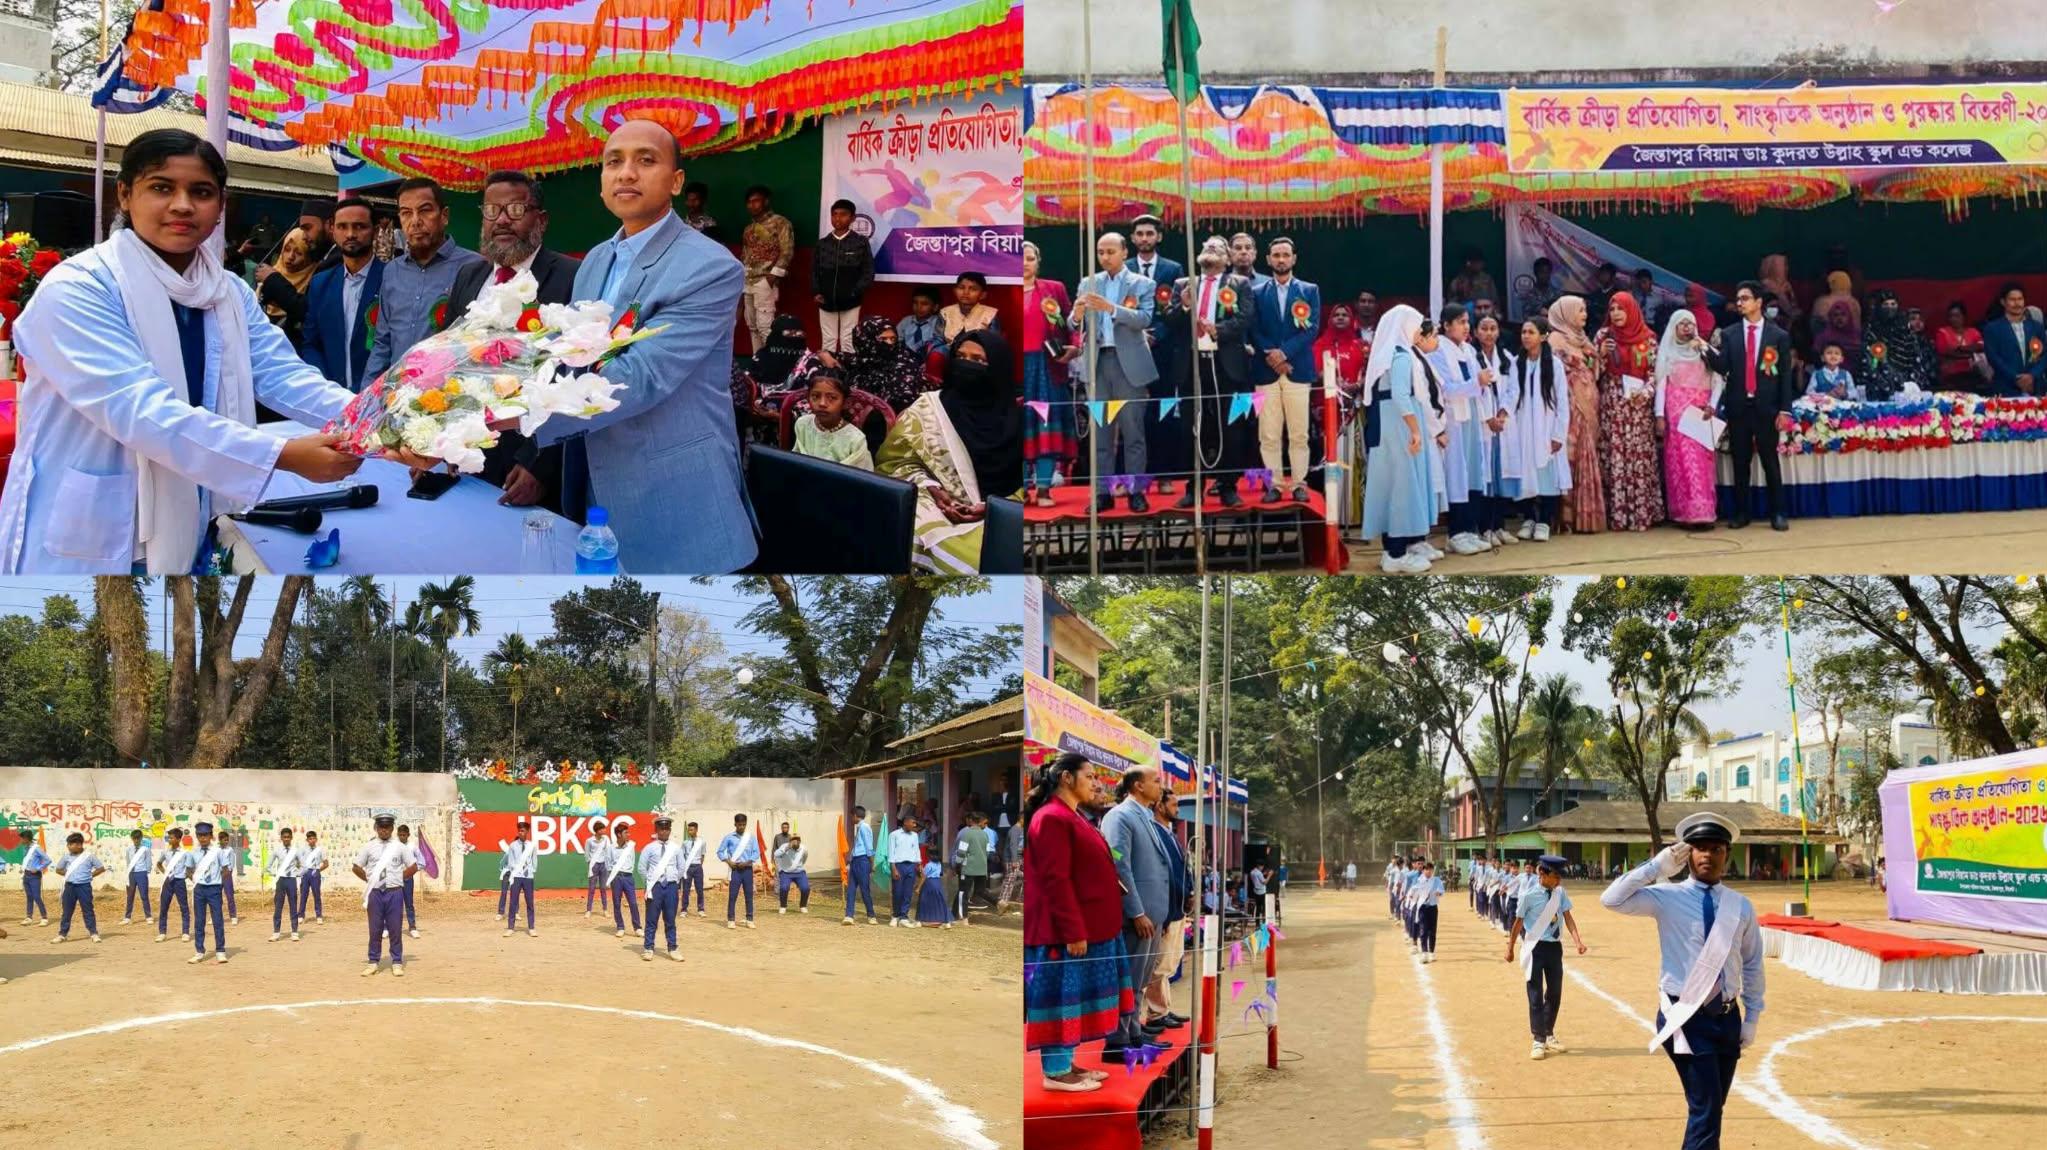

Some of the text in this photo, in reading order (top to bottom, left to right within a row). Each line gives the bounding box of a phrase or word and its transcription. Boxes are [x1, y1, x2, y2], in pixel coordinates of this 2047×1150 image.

[1521, 97, 1571, 129] বার্ষিক
[1577, 96, 1620, 132] ক্রীড়া
[1627, 97, 1729, 132] প্রতিযোগিতা,
[1734, 97, 1812, 135] সাংস্কৃতিক
[1817, 95, 1875, 131] অনুষ্ঠান
[1881, 102, 1895, 123] ও
[847, 102, 1024, 163] বার্ষিক ক্রীড়া প্রতিযোগিতা,
[1632, 145, 1693, 166] জৈন্তাপুর
[1697, 144, 1738, 162] বিয়াম
[1772, 147, 1820, 164] কুদরত
[1823, 142, 1863, 162] উল্লাহ
[1867, 145, 1893, 163] স্কুল
[1898, 145, 1923, 159] এন্ড
[1927, 143, 1973, 159] কলেজ
[905, 230, 1024, 257] জৈন্তাপুর বিয়া
[1977, 777, 2031, 797] প্রতিযোগিতা
[2038, 779, 2046, 792] ও
